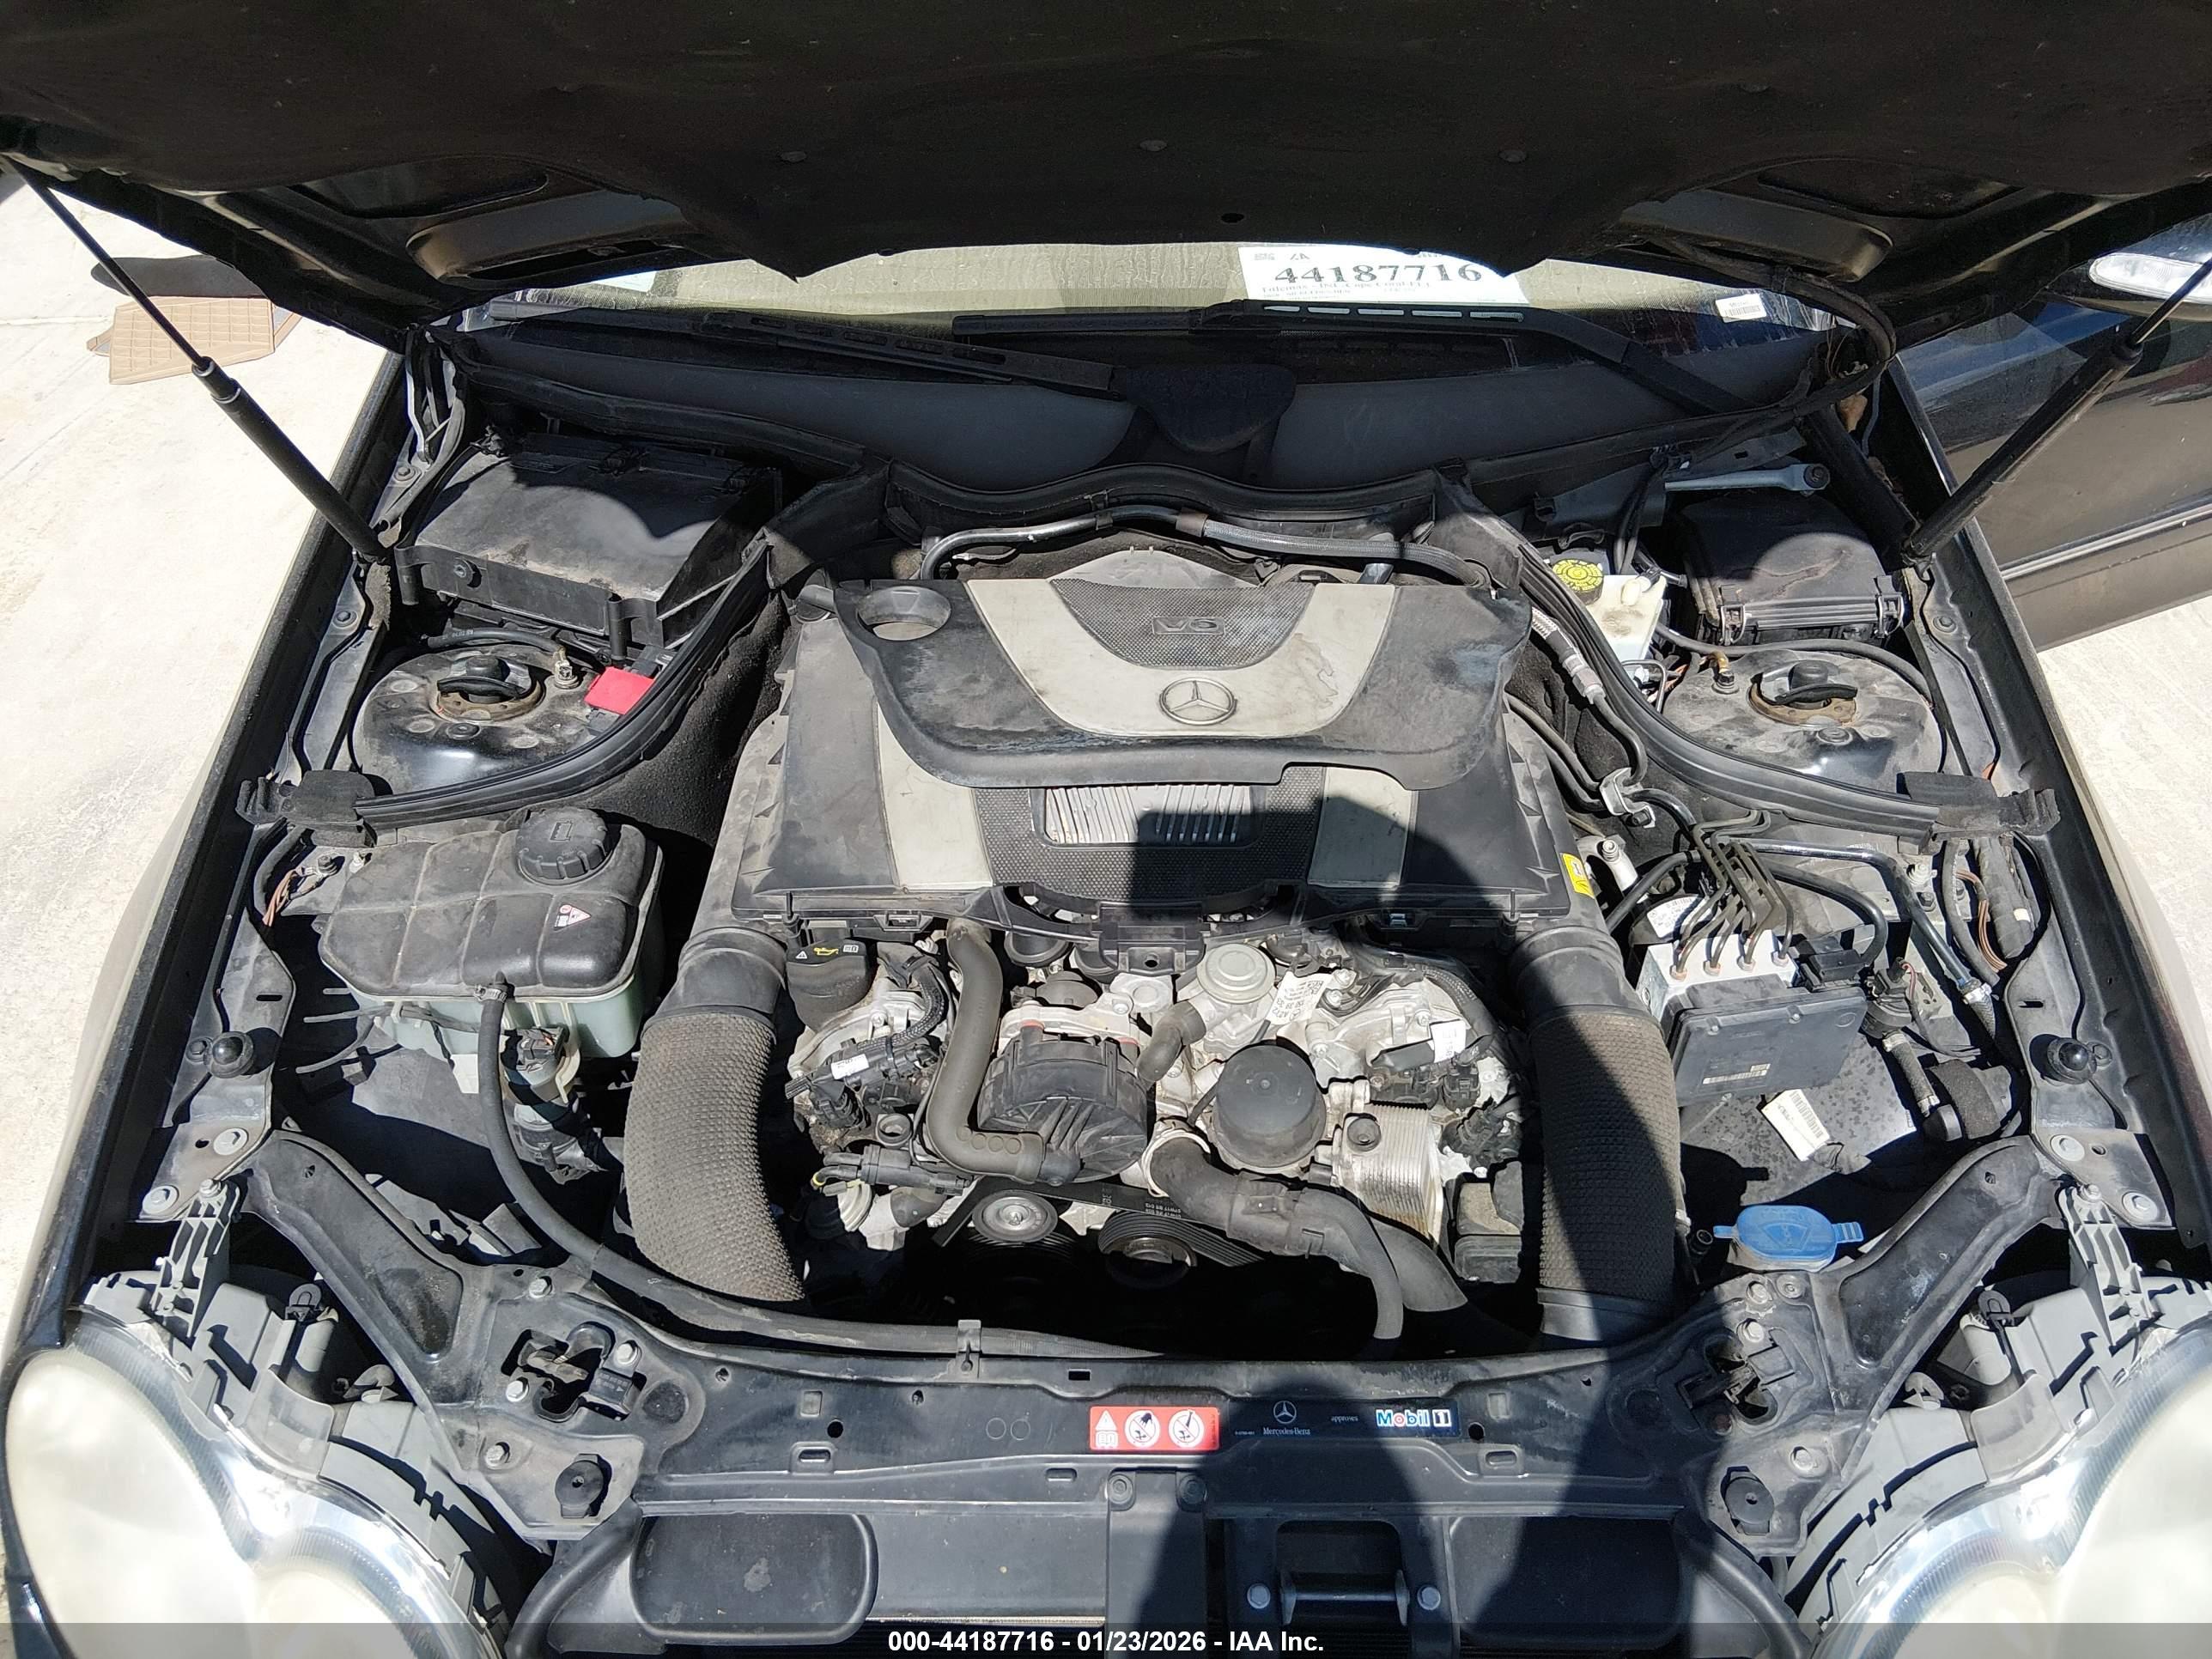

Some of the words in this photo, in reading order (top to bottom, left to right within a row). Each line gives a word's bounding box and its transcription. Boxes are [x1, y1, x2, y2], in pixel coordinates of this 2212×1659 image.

[1274, 263, 1482, 283] 44187716
[1376, 1409, 1430, 1427] Mobil
[1433, 1409, 1452, 1427] 1
[1262, 1426, 1311, 1436] Mercedes-Benz
